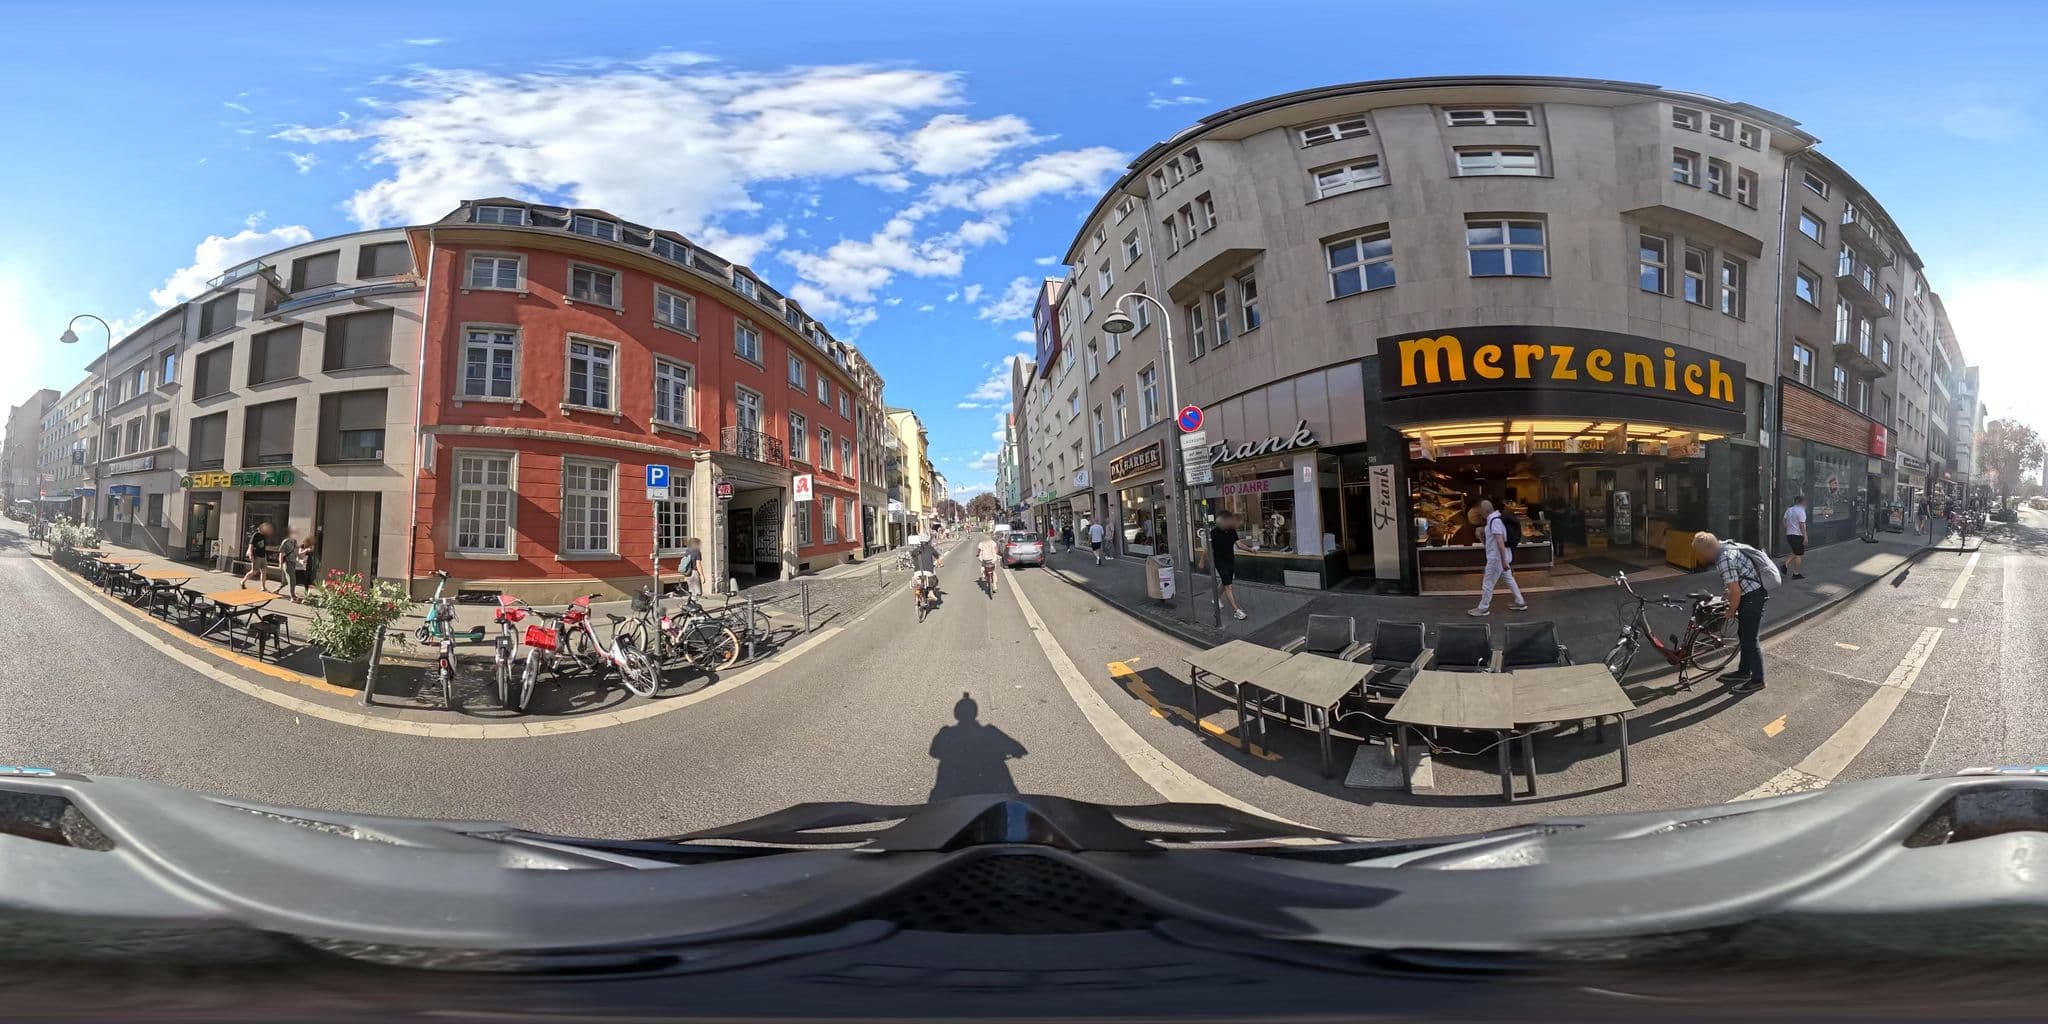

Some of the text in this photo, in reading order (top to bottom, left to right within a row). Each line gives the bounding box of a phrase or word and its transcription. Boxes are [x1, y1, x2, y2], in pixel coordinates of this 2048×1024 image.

[1398, 335, 1734, 403] Merzenich
[1208, 419, 1315, 466] Frank
[651, 467, 664, 485] P
[1124, 449, 1157, 471] BARBER
[1238, 480, 1271, 494] JAHRE
[1373, 467, 1396, 530] Frank
